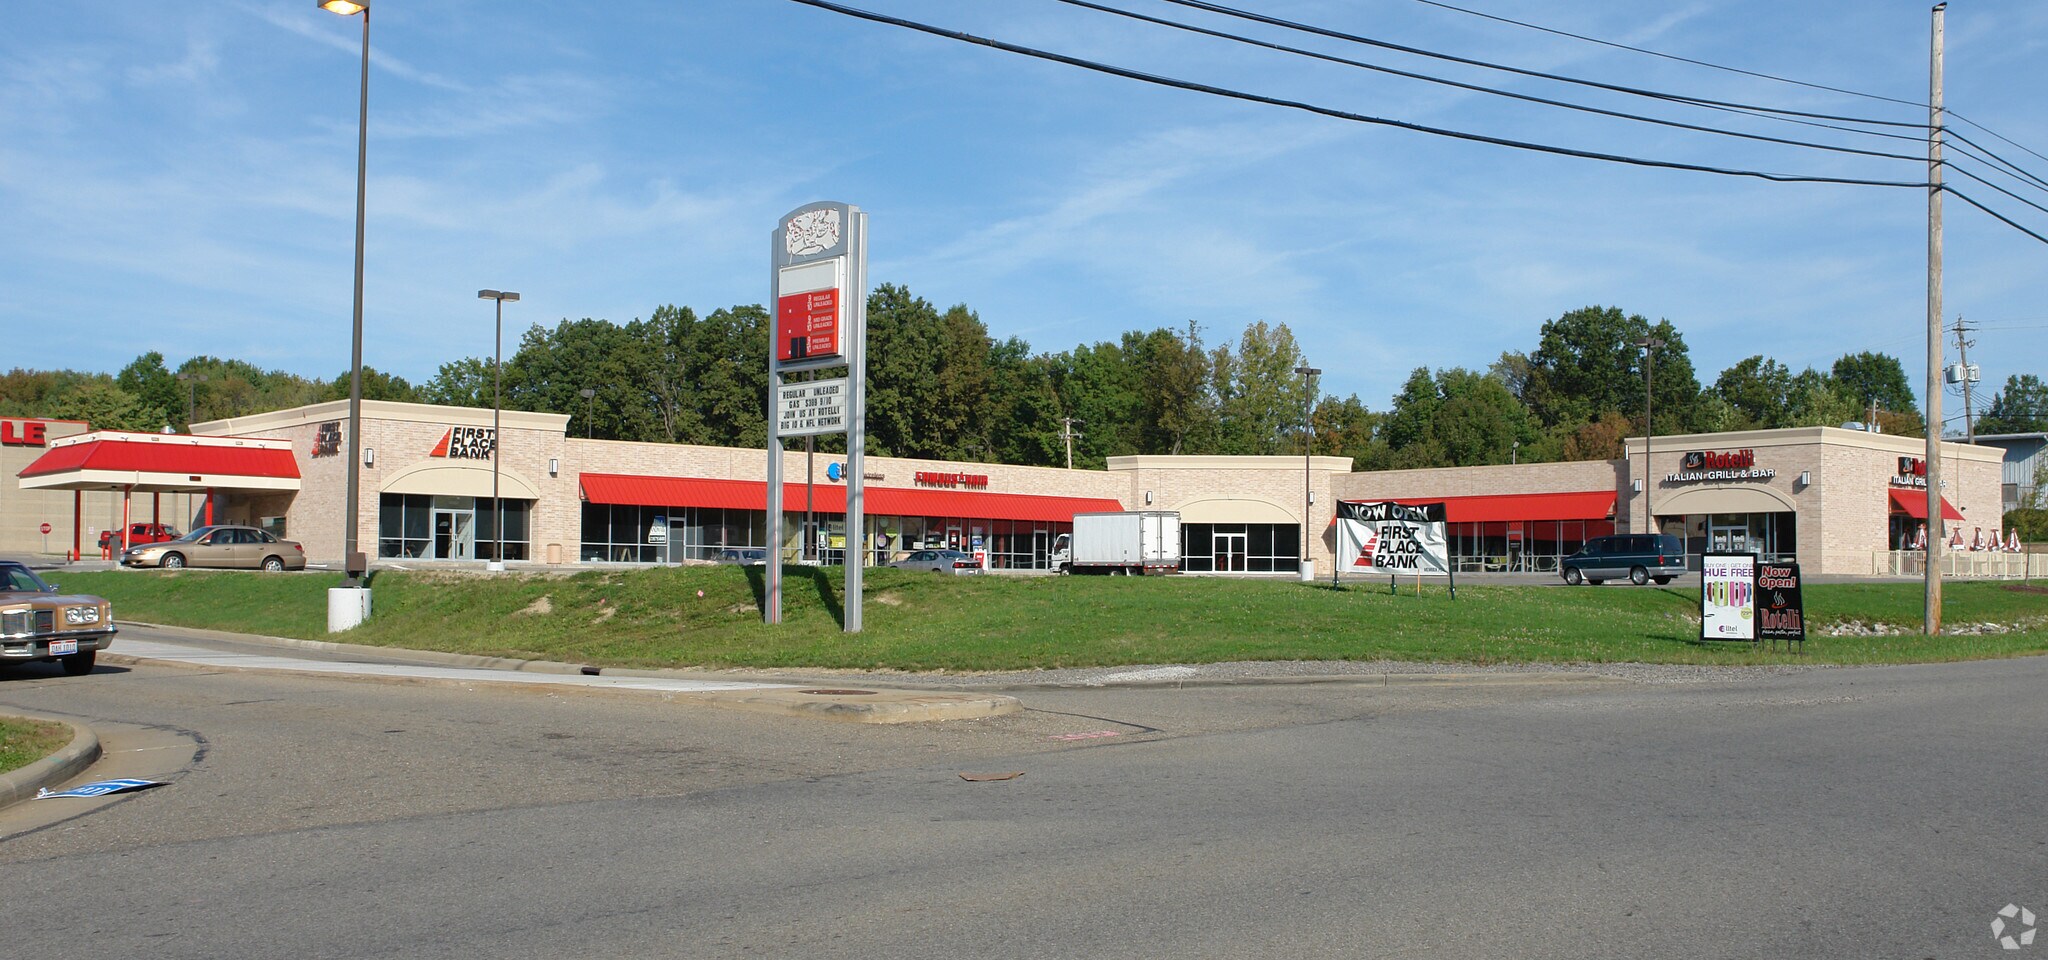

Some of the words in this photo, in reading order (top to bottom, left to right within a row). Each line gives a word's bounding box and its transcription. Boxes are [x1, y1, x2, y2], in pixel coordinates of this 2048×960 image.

[813, 293, 831, 302] REGULAR
[813, 300, 833, 308] UNLEADED
[813, 321, 833, 329] UNLEADED
[812, 337, 830, 345] PREMIUM
[812, 342, 832, 351] UNLEADED
[782, 389, 806, 399] REGULAR
[813, 386, 839, 396] UNLEADED
[789, 400, 800, 409] GAS
[783, 410, 796, 419] JOIN
[799, 409, 806, 418] US
[808, 408, 815, 417] AT
[818, 406, 840, 416] ROTELLI
[781, 421, 790, 430] BIG
[800, 419, 804, 428] &
[806, 419, 815, 427] NFL
[818, 416, 841, 426] NETWORK
[452, 427, 496, 440] FIRST
[450, 437, 496, 451] PLACE
[449, 446, 491, 460] BANK
[1705, 449, 1755, 469] Rotelli
[1665, 473, 1703, 482] ITALIAN
[1708, 471, 1738, 480] GRILL
[1740, 469, 1748, 479] &
[1752, 469, 1776, 478] BAR
[1893, 476, 1914, 485] ITALIAN
[1348, 504, 1387, 520] NOW
[1391, 503, 1429, 521] OPEN
[1381, 525, 1419, 540] FIRST
[1377, 540, 1425, 554] PLACE
[1375, 554, 1419, 569] BANK
[1704, 568, 1727, 577] HUE
[1730, 568, 1754, 577] FREE
[1762, 566, 1792, 577] Now
[1759, 577, 1796, 590] Open!
[1760, 608, 1801, 630] Rotelli
